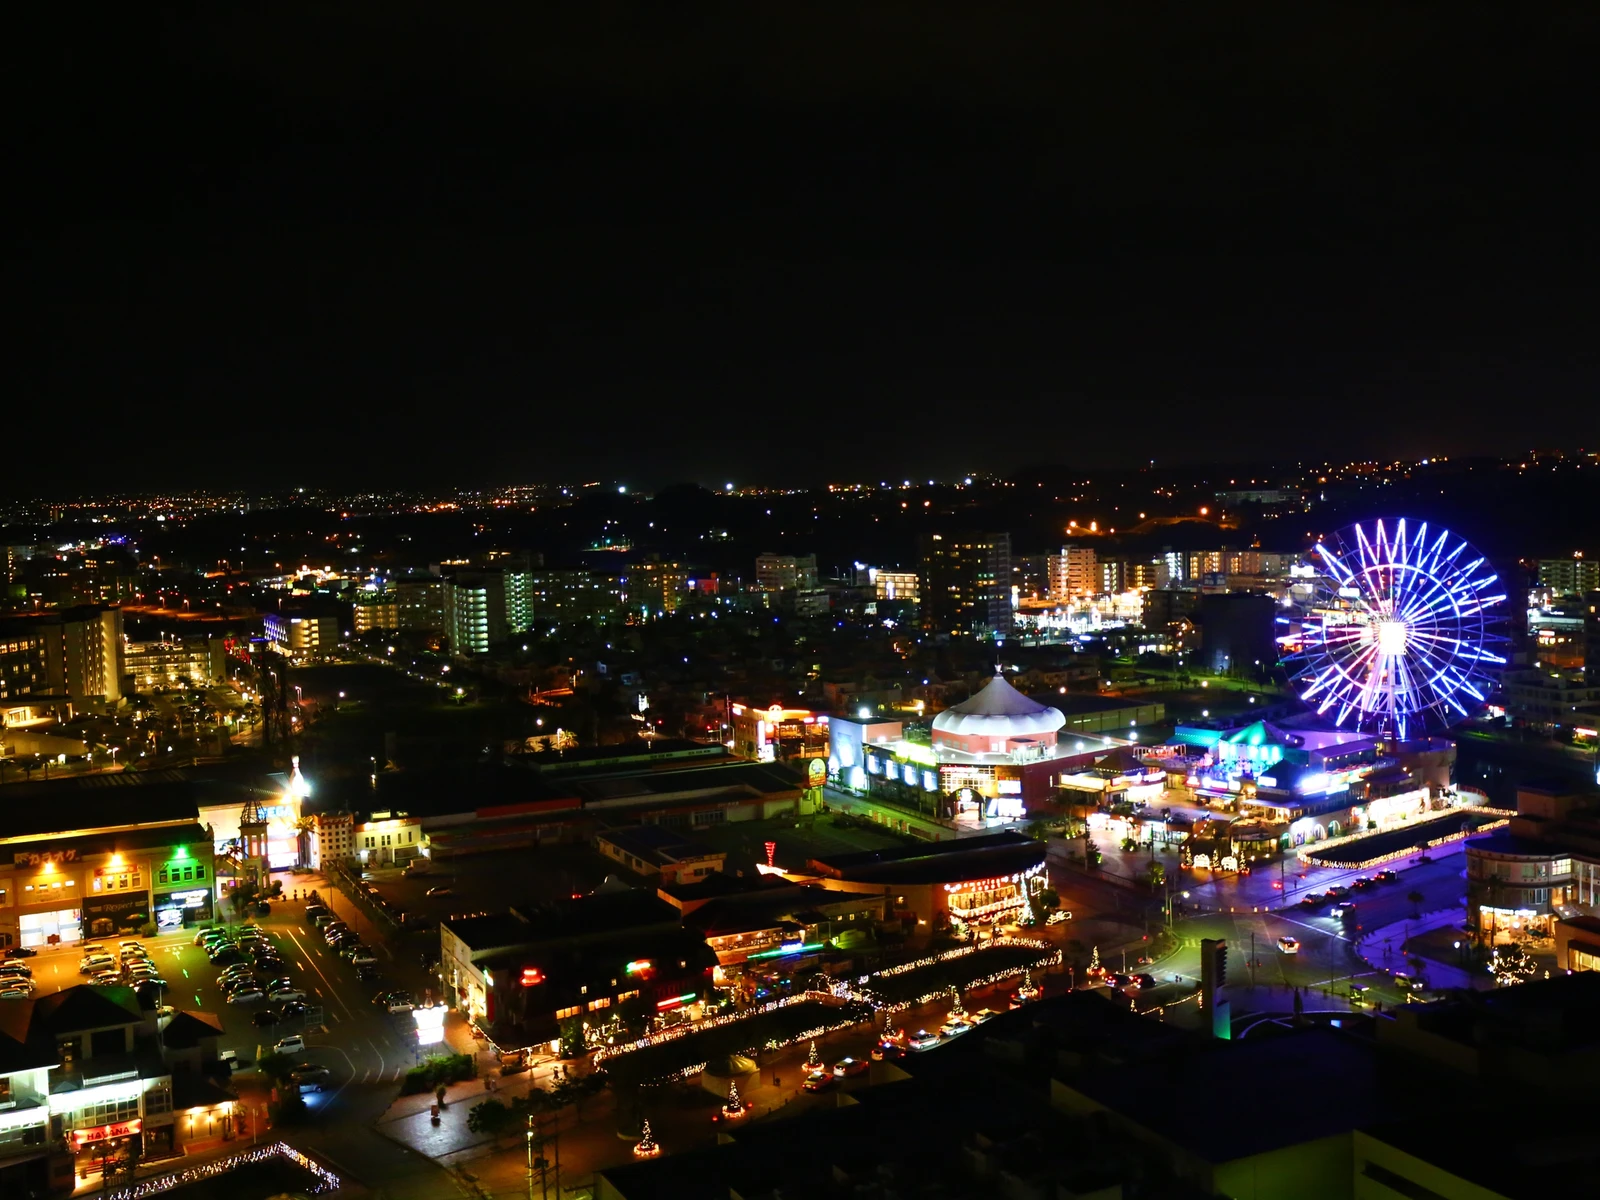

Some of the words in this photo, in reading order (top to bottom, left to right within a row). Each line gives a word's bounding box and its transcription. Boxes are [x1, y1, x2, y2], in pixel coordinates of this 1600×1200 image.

[257, 806, 293, 820] SEGA
[29, 849, 77, 866] カラオケ
[87, 1127, 130, 1140] HAVANA
